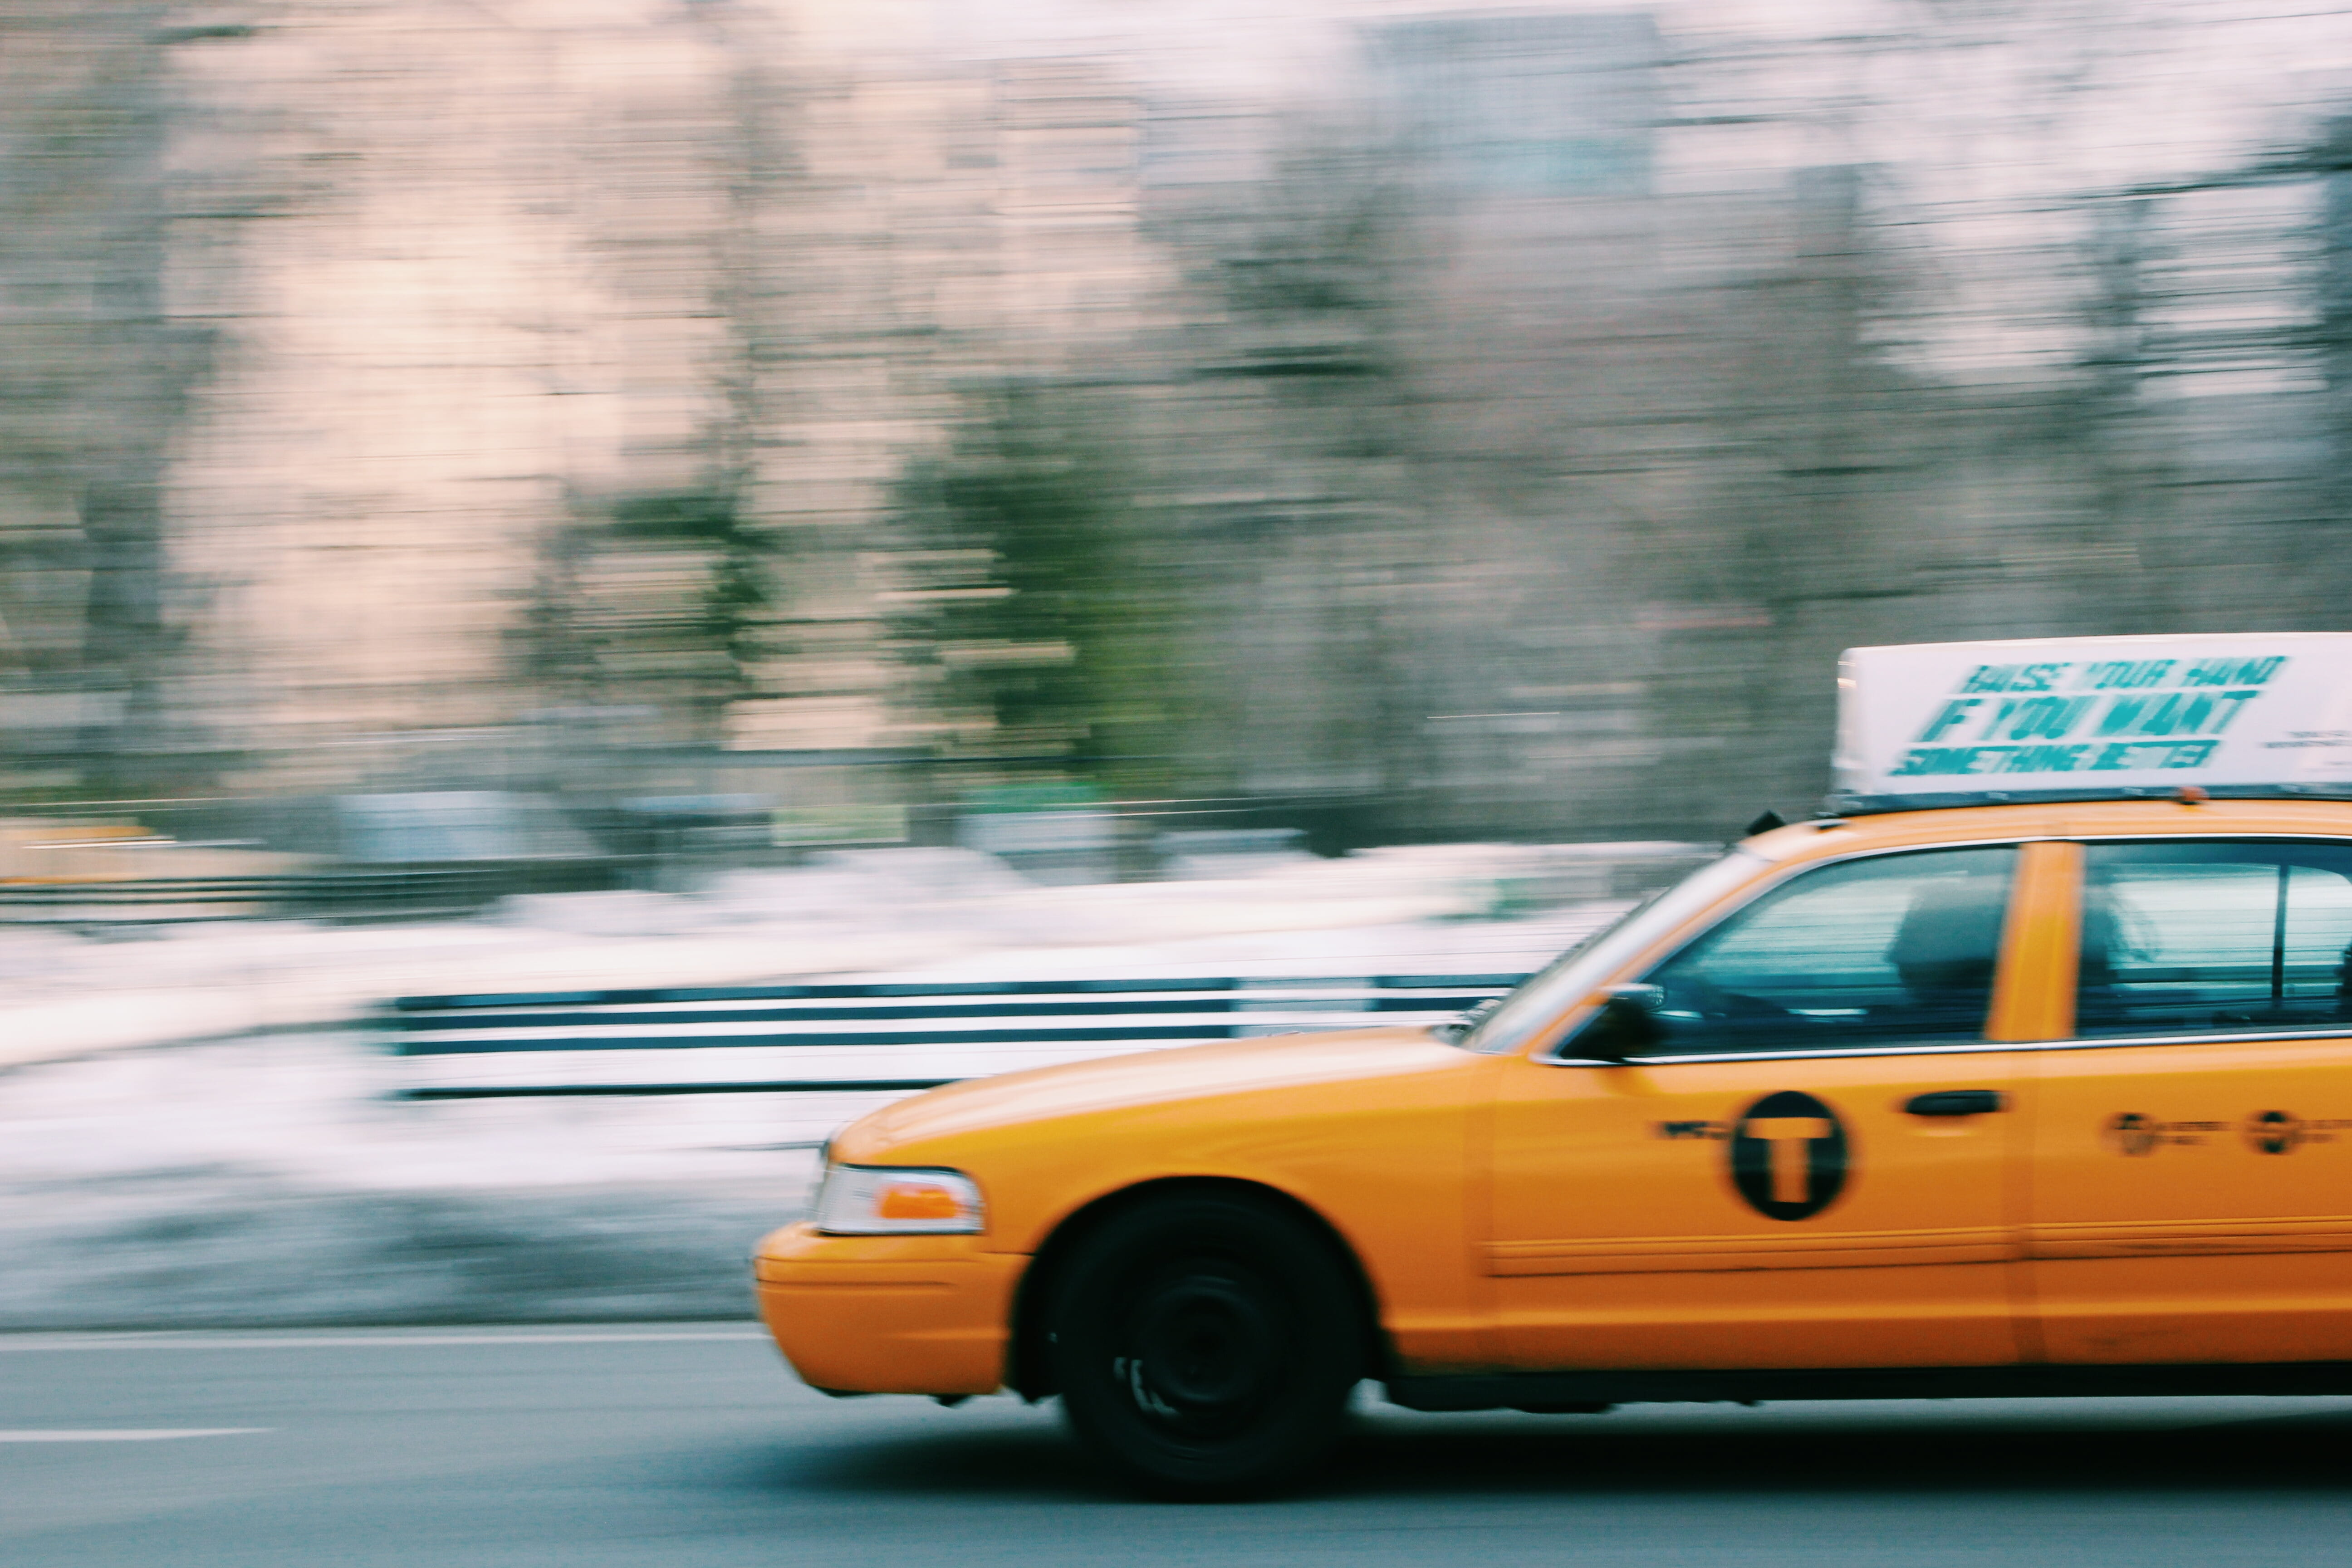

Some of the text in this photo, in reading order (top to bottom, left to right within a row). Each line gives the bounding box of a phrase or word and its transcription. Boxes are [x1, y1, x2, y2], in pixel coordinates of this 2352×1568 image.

[2080, 659, 2179, 691] YOUR
[1911, 690, 2262, 742] IF YOU WANT
